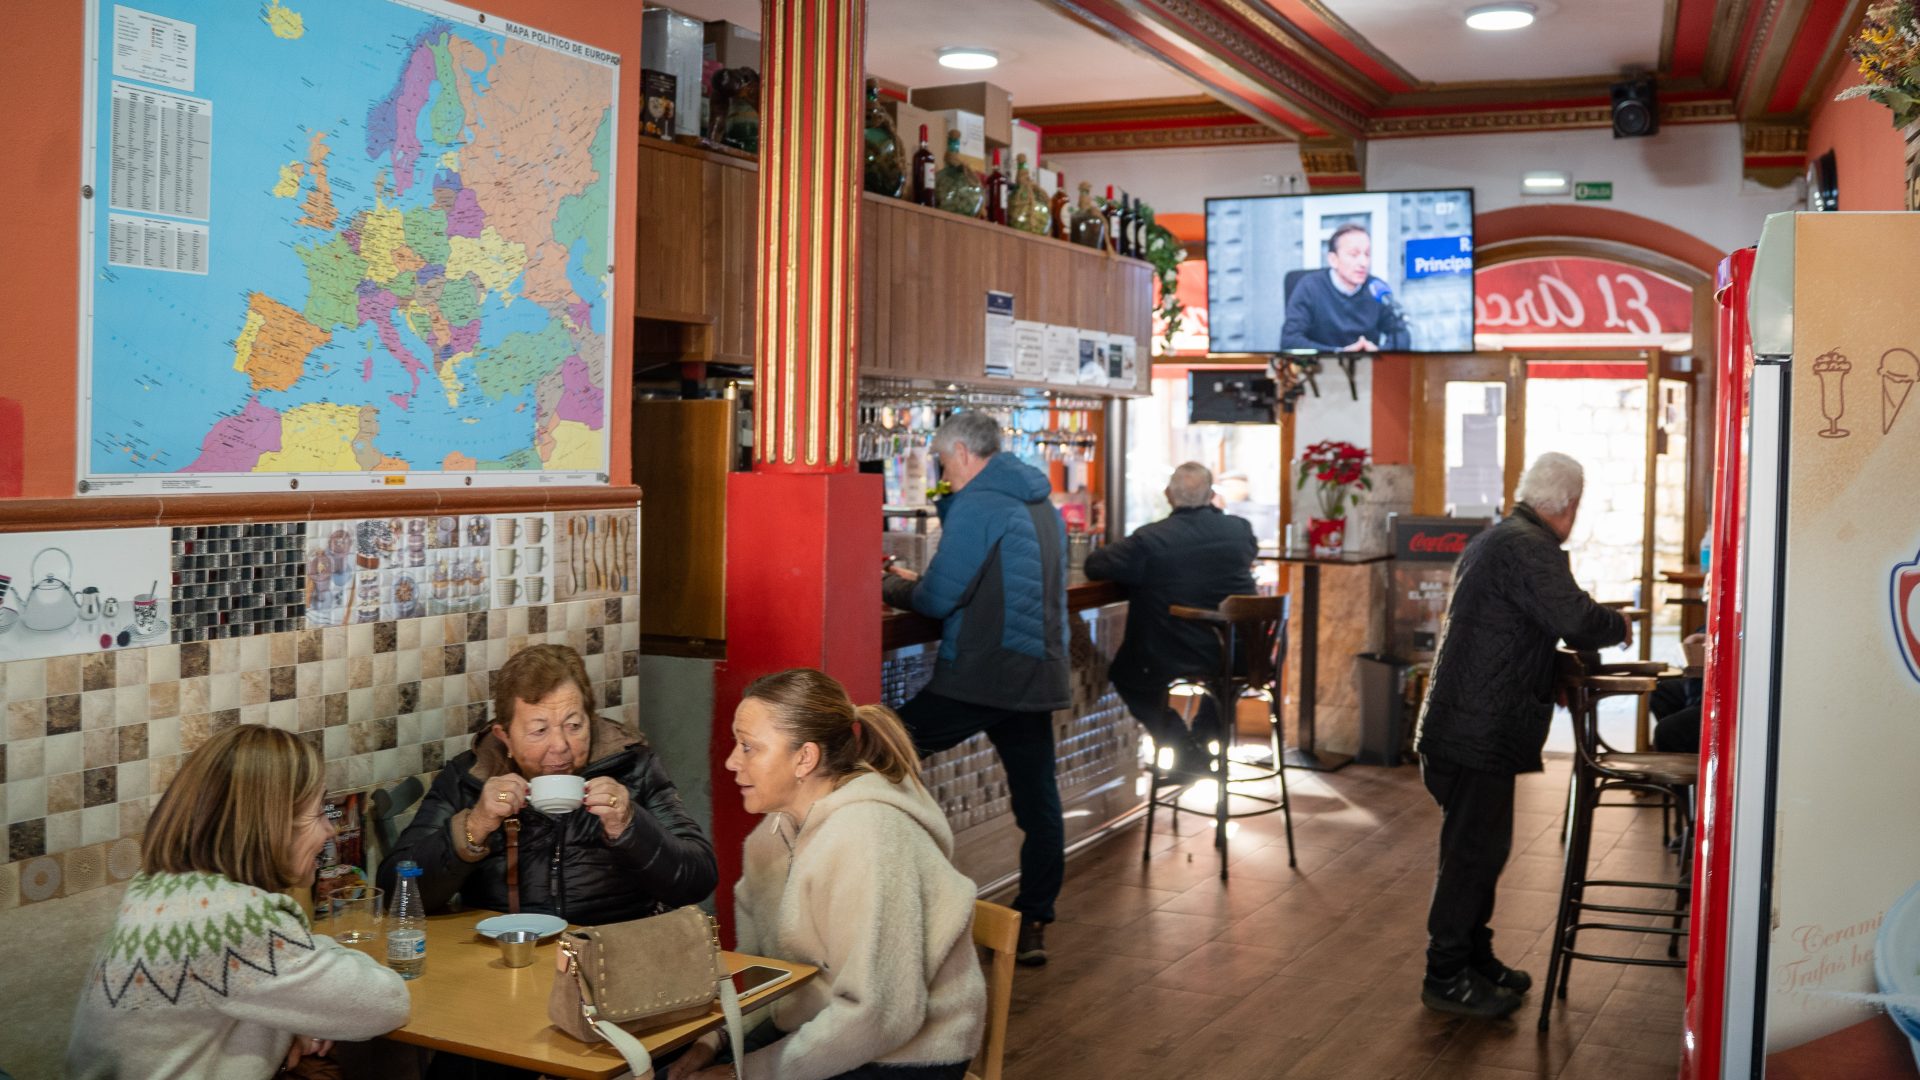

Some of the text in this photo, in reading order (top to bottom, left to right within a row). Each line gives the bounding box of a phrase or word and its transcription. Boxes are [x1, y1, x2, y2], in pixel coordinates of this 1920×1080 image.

[505, 22, 529, 38] MAPA
[531, 30, 570, 50] POLÍTICO
[572, 43, 583, 54] DE
[1419, 581, 1442, 592] BAR
